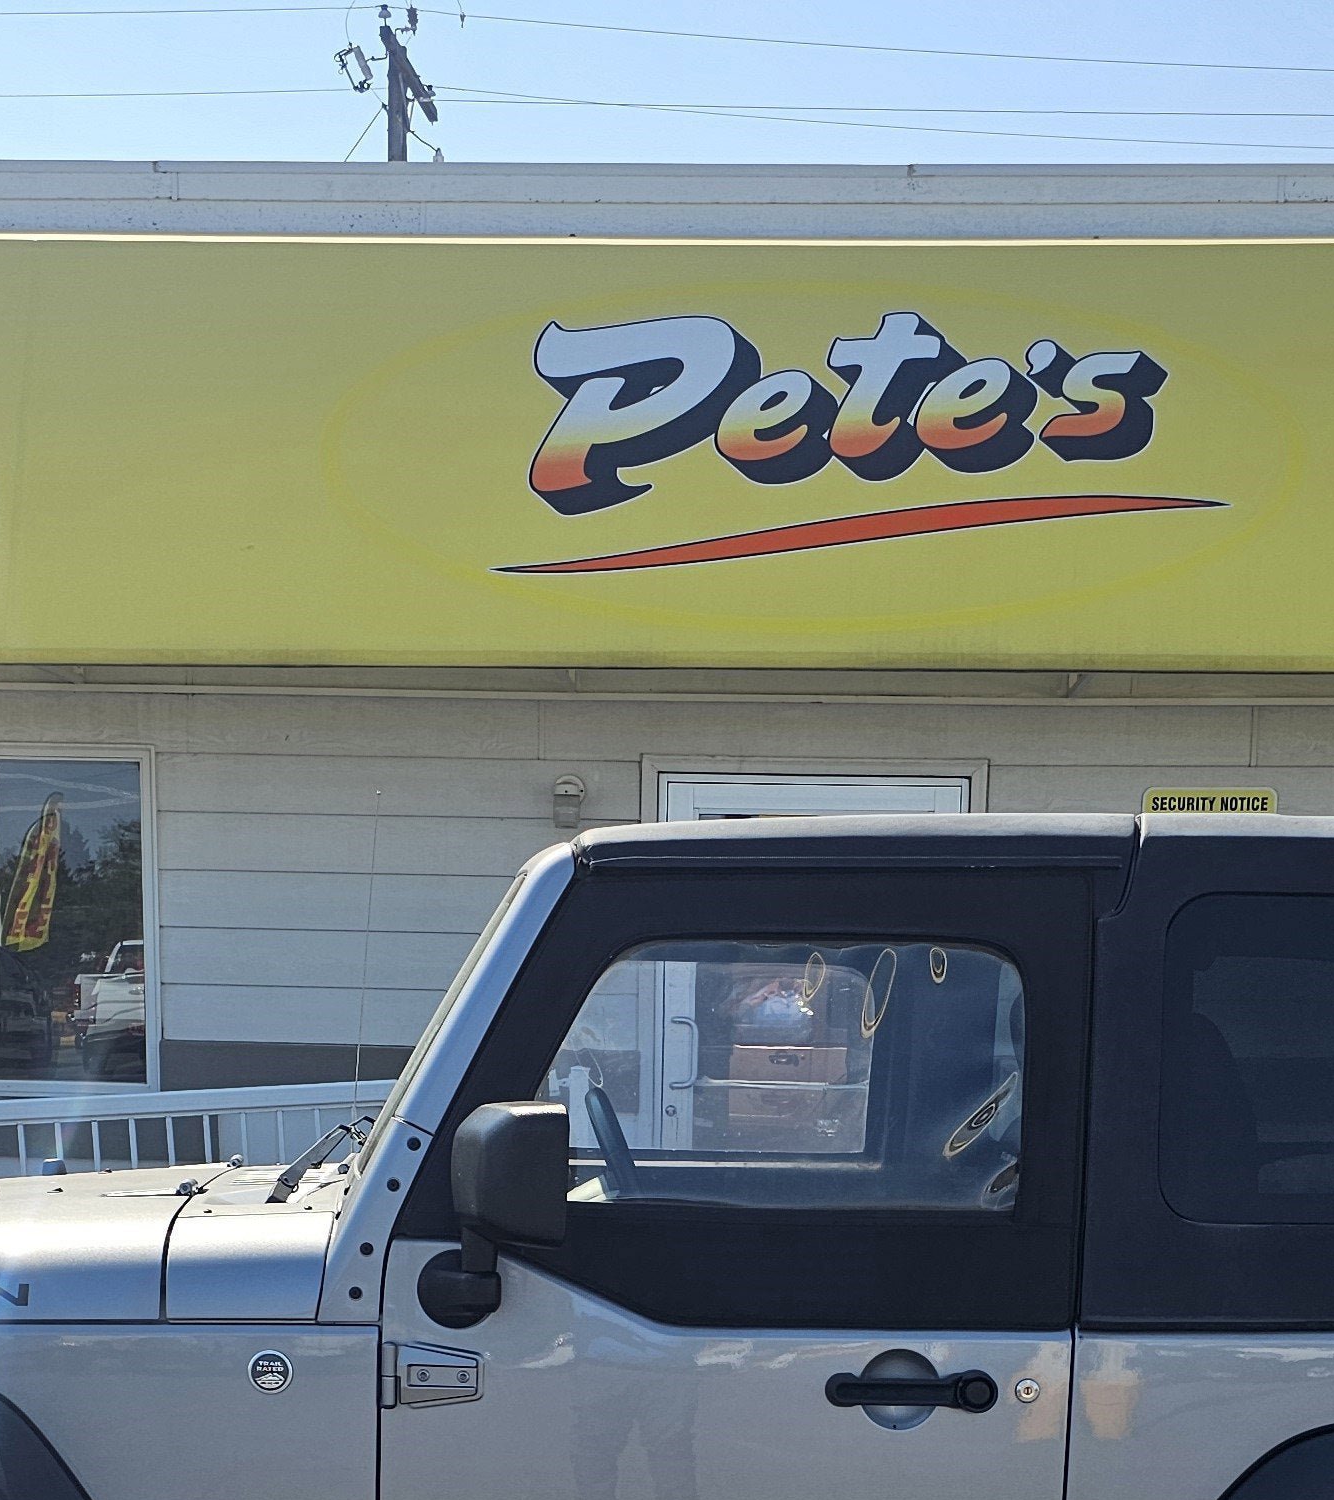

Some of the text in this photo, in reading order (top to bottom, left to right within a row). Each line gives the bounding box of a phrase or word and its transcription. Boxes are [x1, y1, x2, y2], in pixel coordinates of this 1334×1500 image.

[528, 310, 1169, 517] Pete's
[1151, 796, 1269, 812] SECURITY NOTICE
